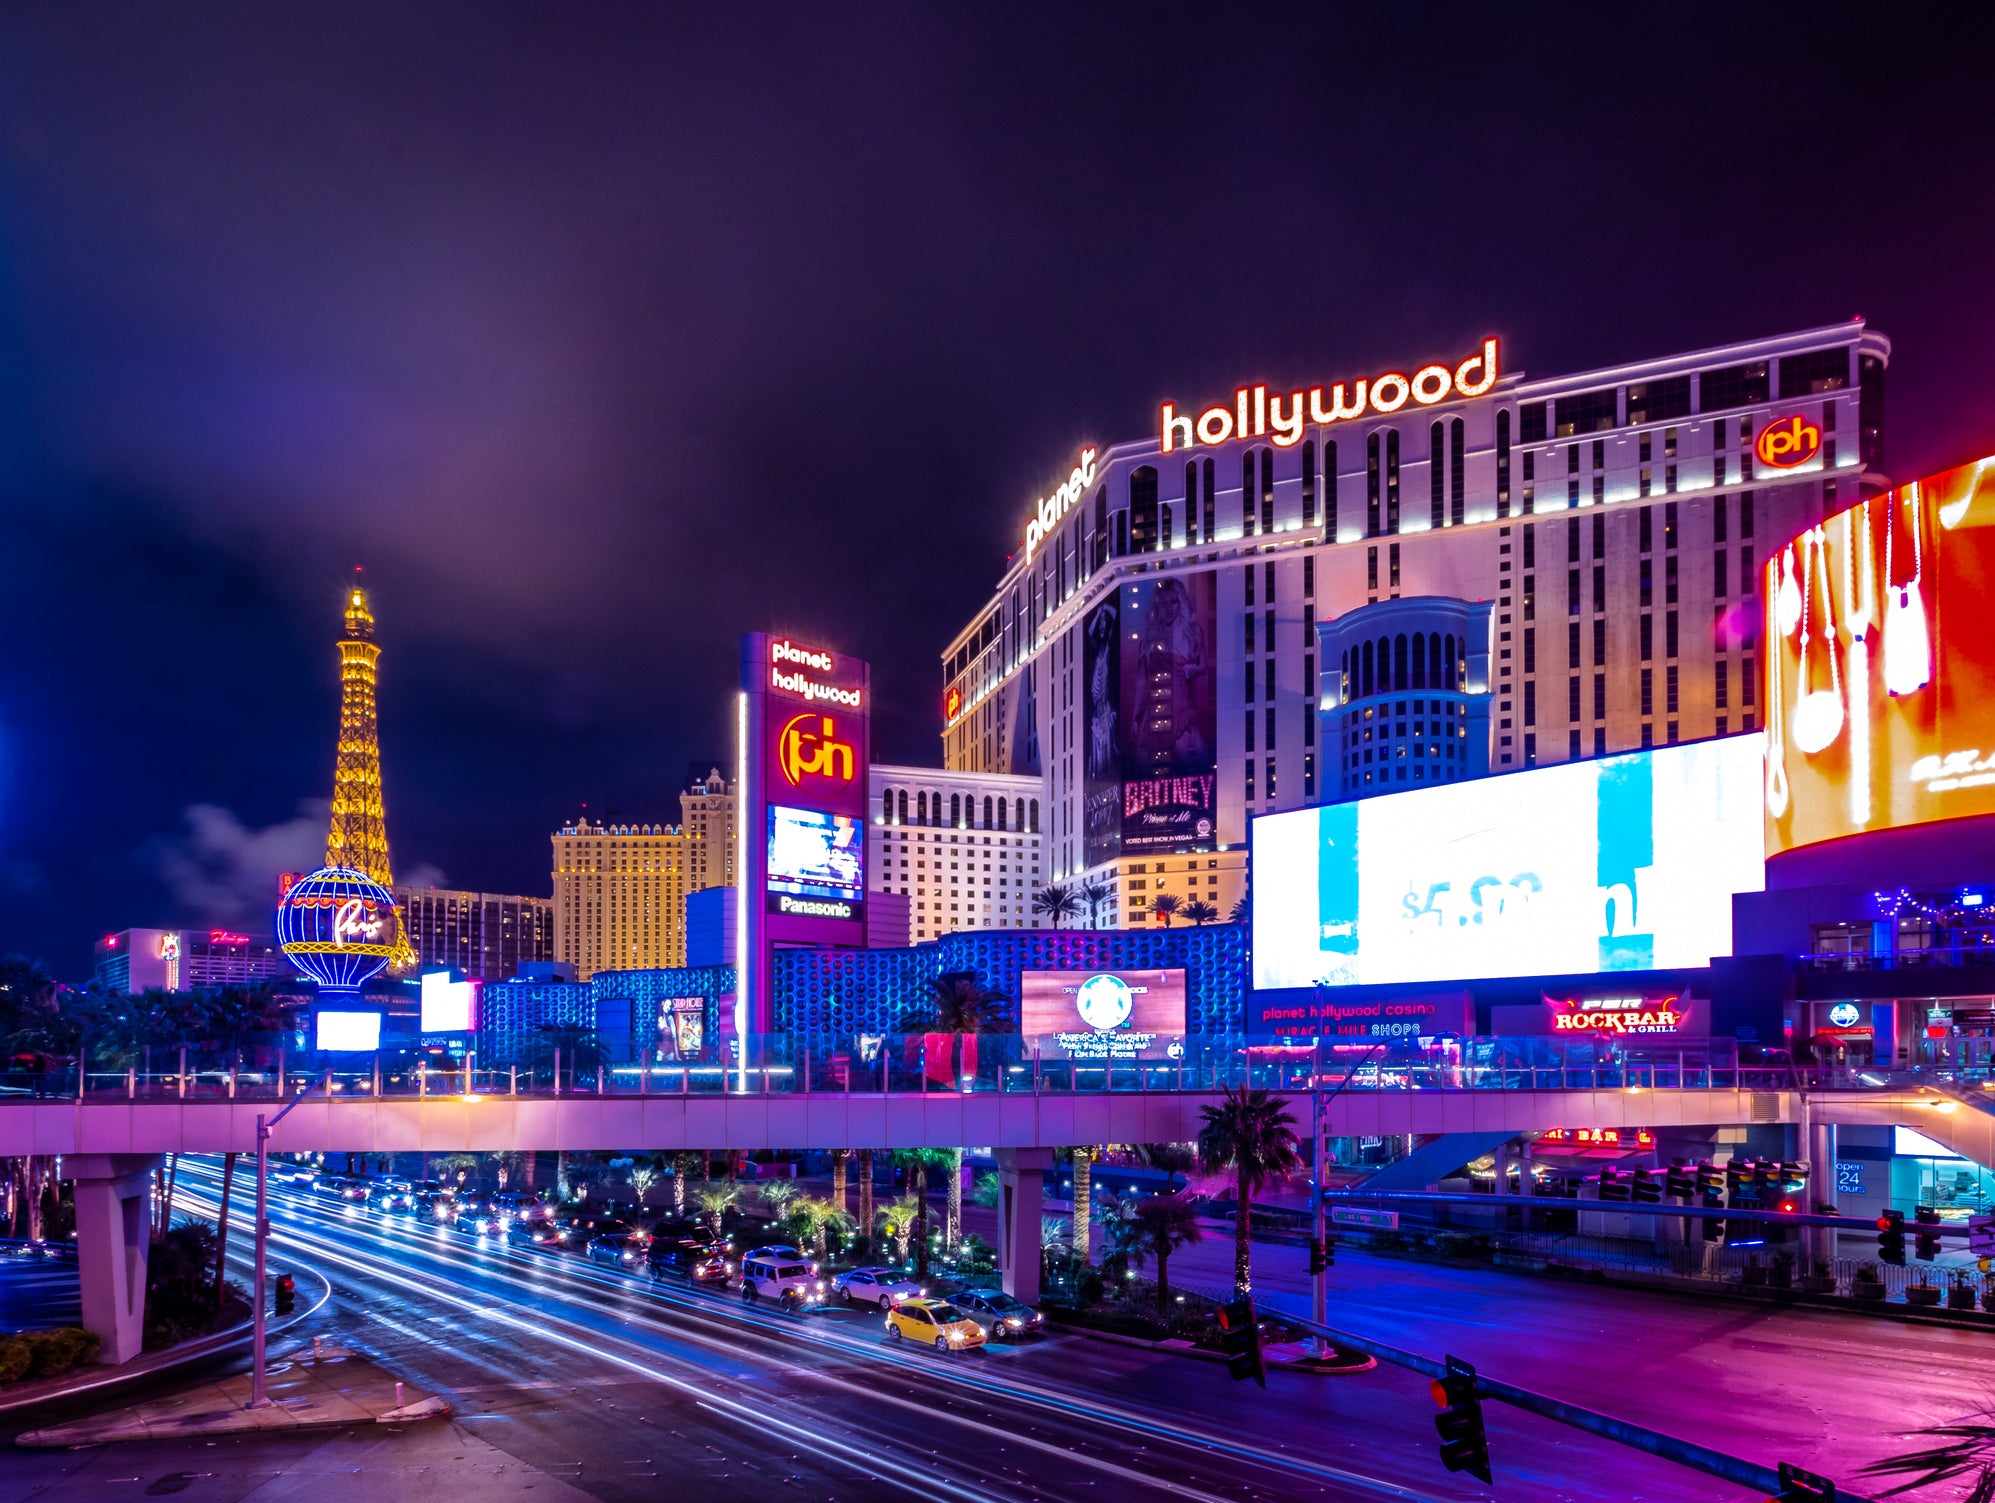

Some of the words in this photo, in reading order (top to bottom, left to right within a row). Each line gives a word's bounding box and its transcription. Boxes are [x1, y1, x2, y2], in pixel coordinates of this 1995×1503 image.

[1160, 337, 1500, 454] hollywood
[1766, 417, 1818, 461] ph
[1025, 446, 1097, 567] planet
[772, 641, 832, 670] planet
[772, 667, 861, 707] hollywood
[789, 717, 853, 783] ph
[1124, 775, 1213, 818] BRITNEY
[1174, 834, 1193, 842] VEGAS
[780, 896, 851, 918] Panasonic
[335, 899, 383, 948] Paris
[1263, 1007, 1305, 1022] planet
[1309, 1003, 1381, 1021] hollywood
[1385, 1003, 1435, 1016] casino
[1275, 1026, 1330, 1036] MIRACE
[1337, 1025, 1367, 1036] MILE
[1371, 1023, 1421, 1036] SHOPS
[1578, 1130, 1618, 1141] BAR
[1836, 1163, 1864, 1171] open
[1839, 1171, 1860, 1185] 24
